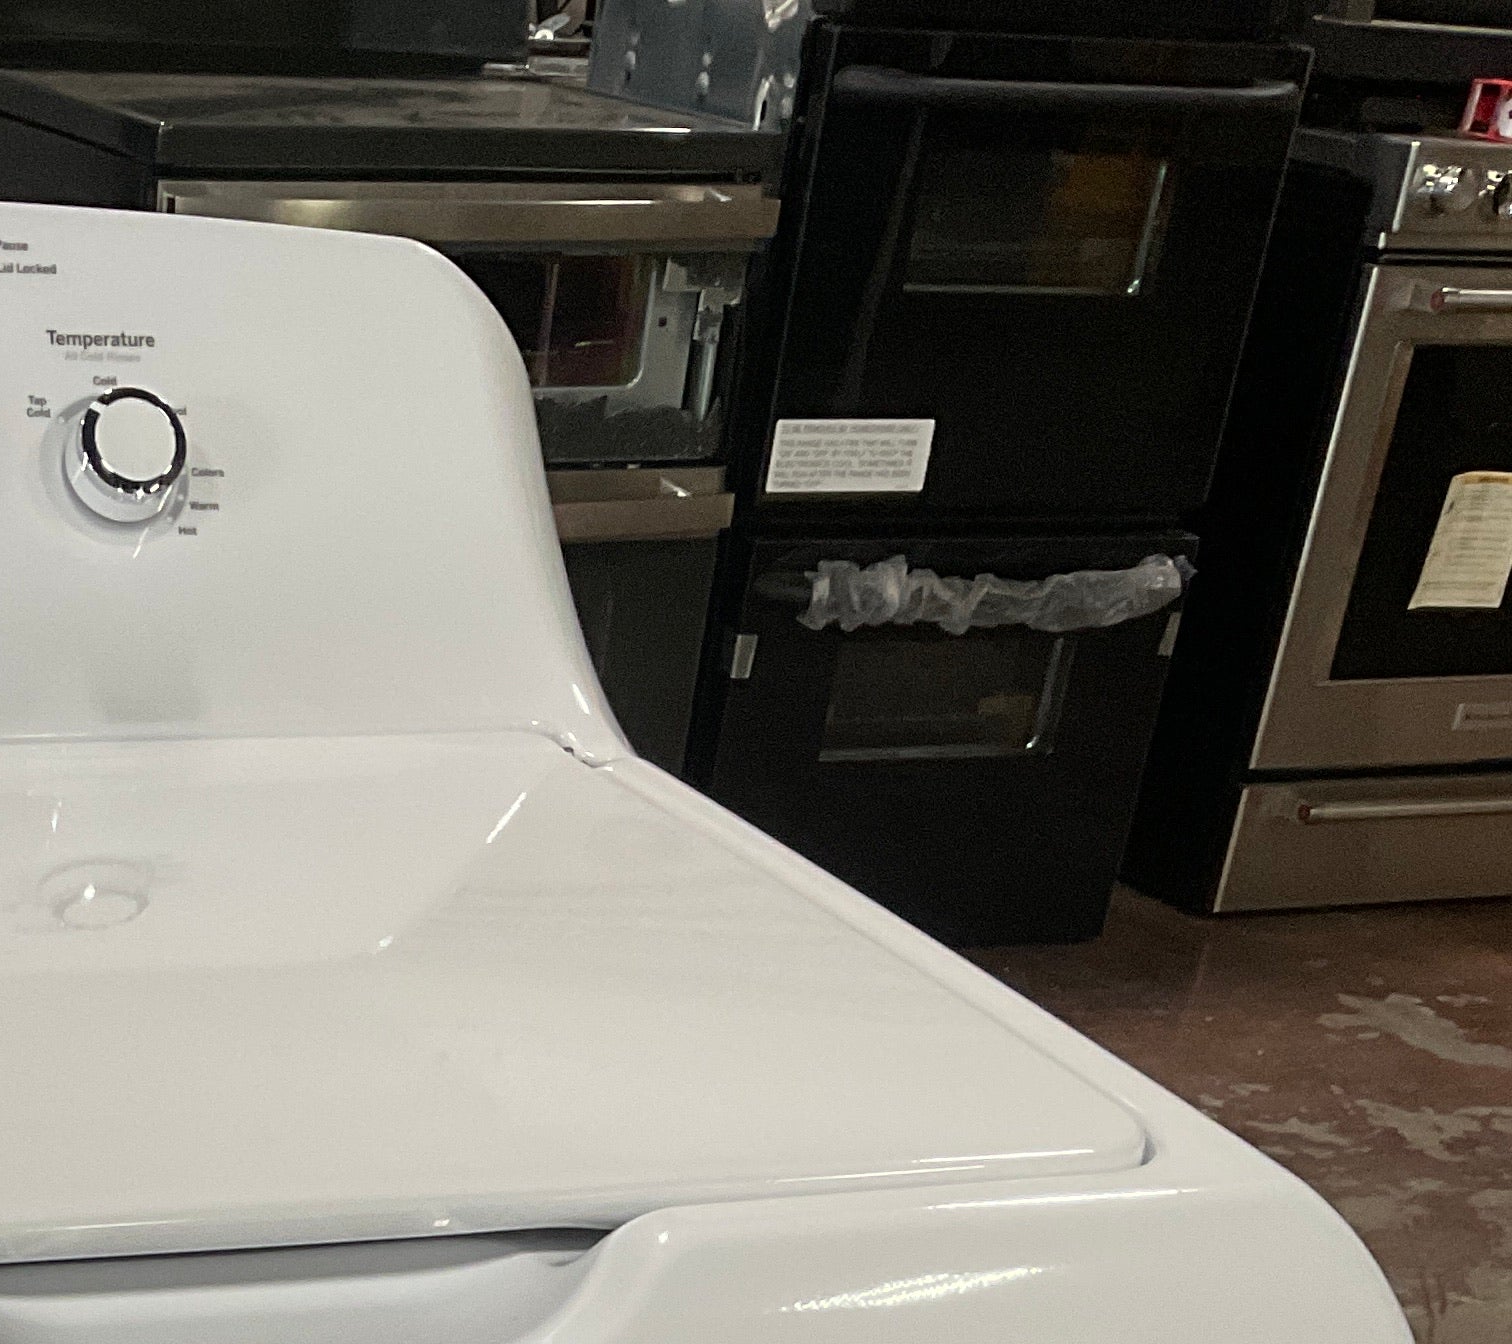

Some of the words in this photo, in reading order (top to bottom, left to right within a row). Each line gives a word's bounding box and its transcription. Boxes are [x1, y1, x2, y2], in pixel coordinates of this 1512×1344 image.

[16, 263, 57, 275] Locked
[46, 329, 156, 350] Temperature
[92, 375, 118, 387] Cold
[28, 394, 47, 406] Tap
[26, 407, 52, 418] Cold
[189, 501, 220, 512] Warm
[178, 526, 198, 537] Hot
